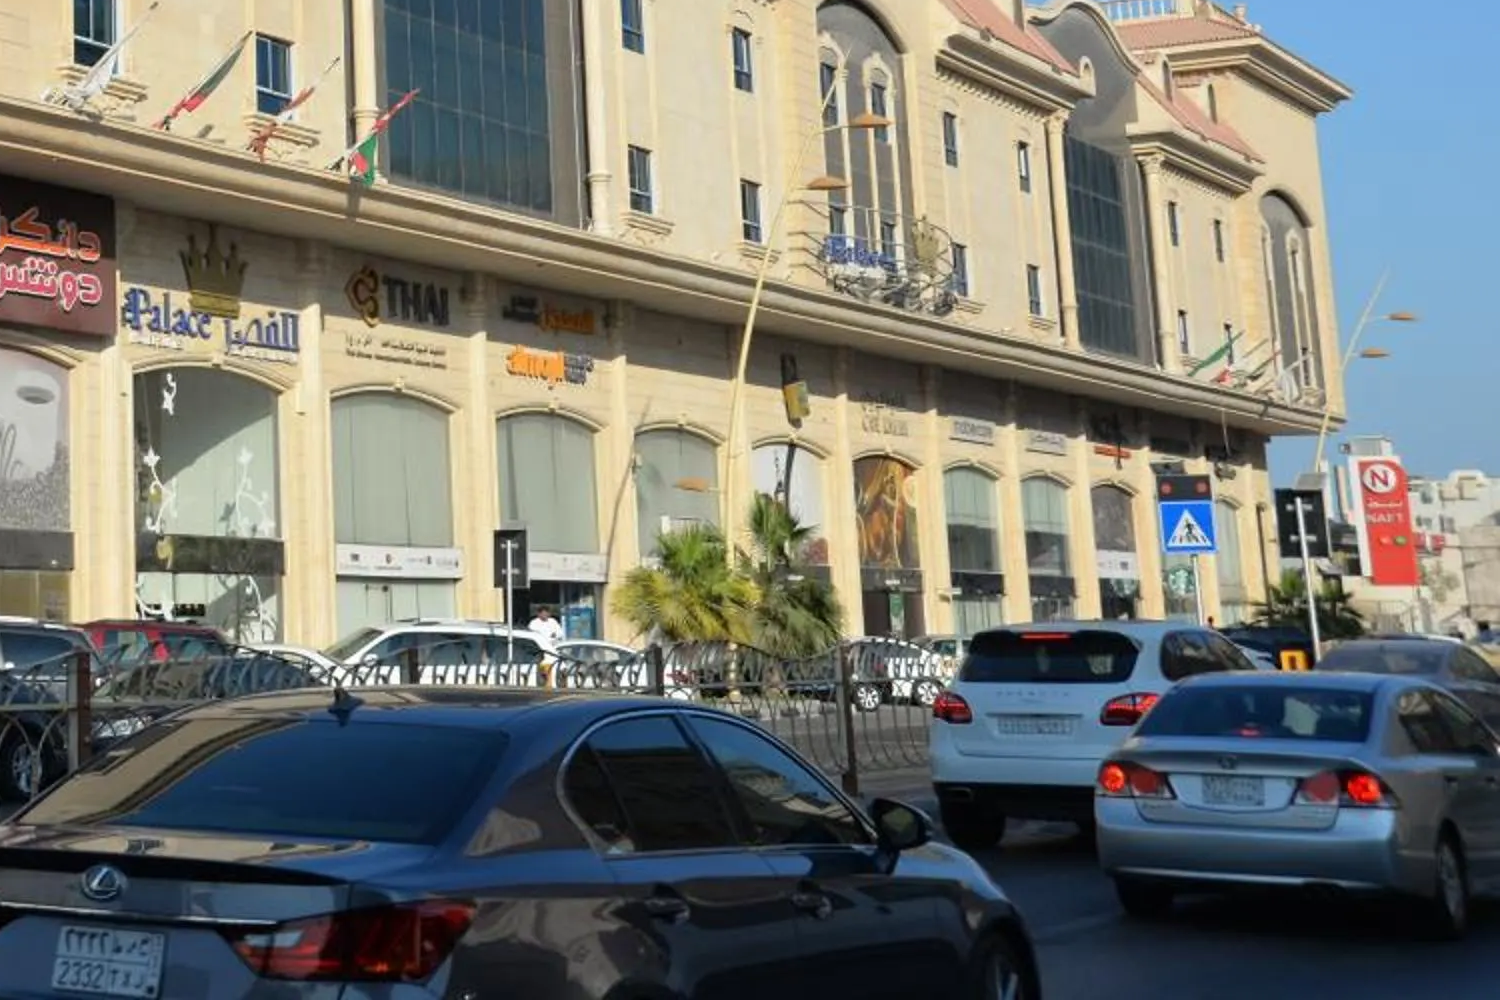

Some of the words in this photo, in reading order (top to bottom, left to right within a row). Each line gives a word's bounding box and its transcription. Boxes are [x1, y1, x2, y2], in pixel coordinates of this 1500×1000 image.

[126, 287, 213, 340] Palace
[381, 274, 449, 328] THAI
[57, 961, 104, 989] 2332
